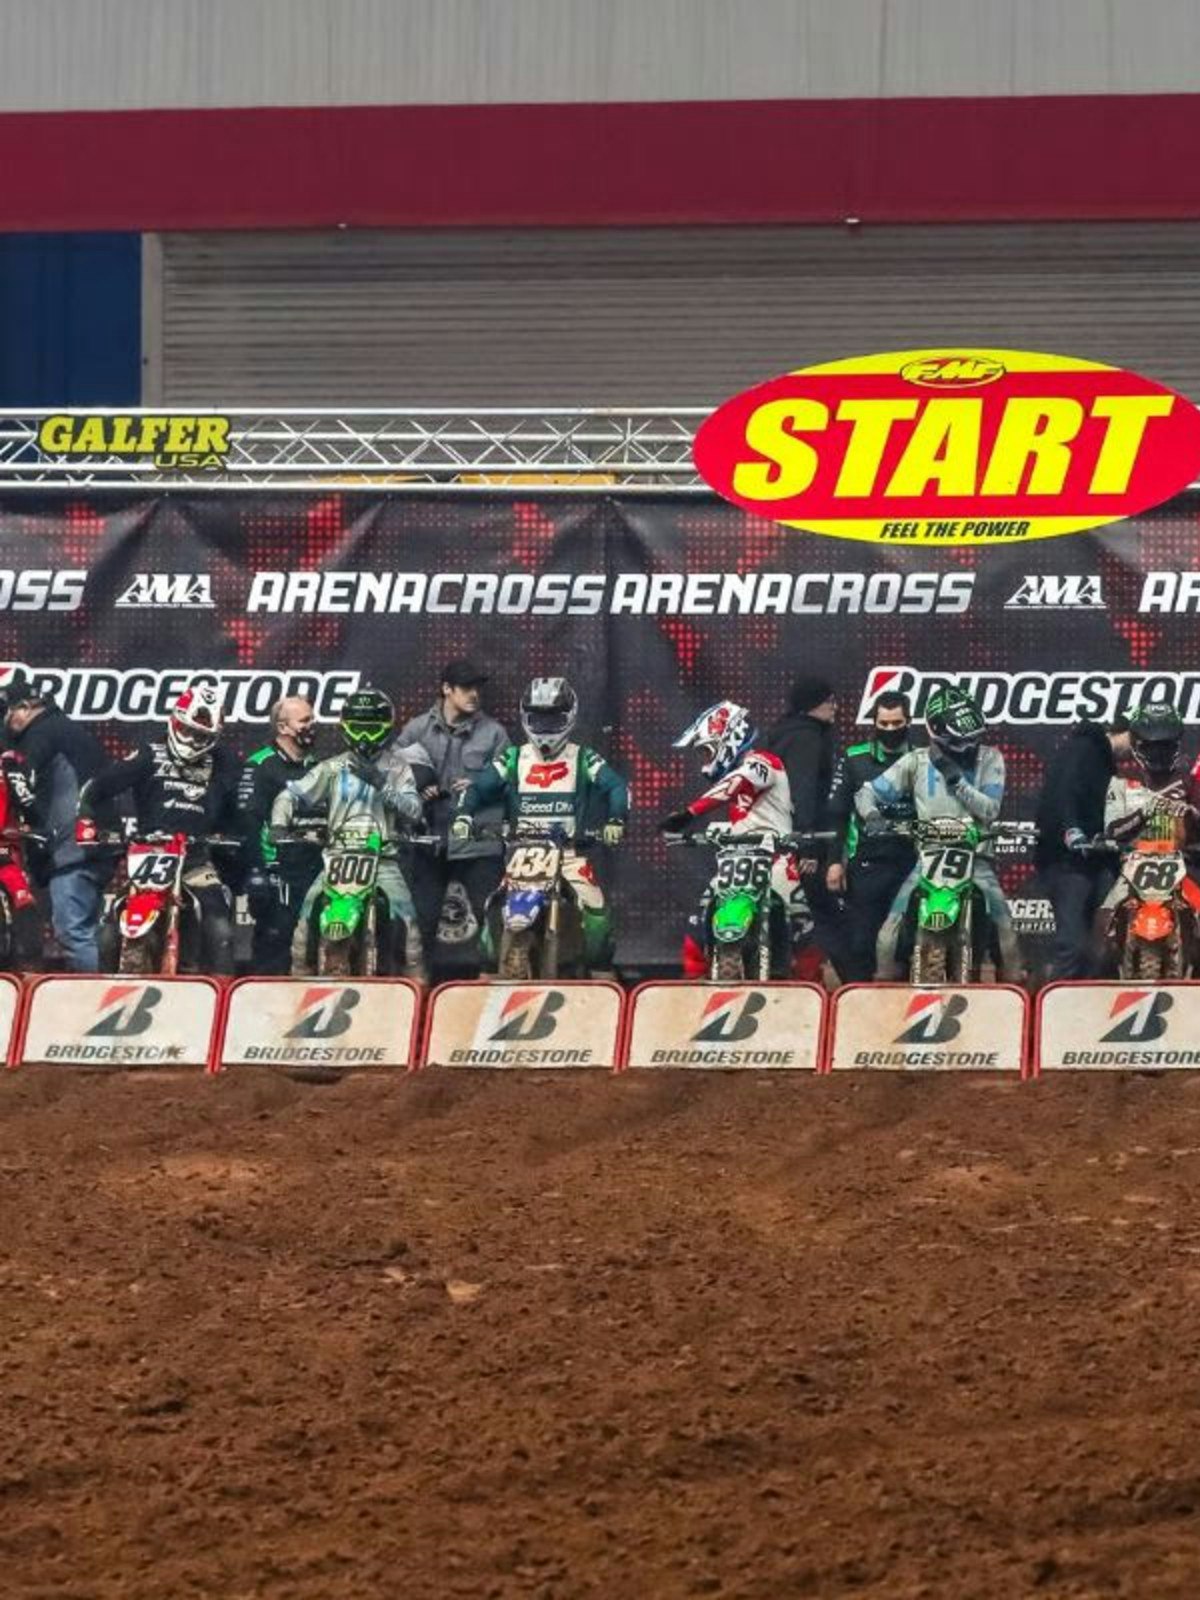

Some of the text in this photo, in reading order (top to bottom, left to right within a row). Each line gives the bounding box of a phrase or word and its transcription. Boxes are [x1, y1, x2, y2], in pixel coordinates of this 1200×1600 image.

[903, 358, 1003, 381] FMF
[40, 416, 229, 453] GALFER
[732, 396, 1174, 499] START
[155, 453, 224, 468] USA
[880, 521, 1030, 538] FEEL THE POWER
[0, 570, 88, 610] OSS
[115, 573, 213, 603] AMA
[247, 571, 606, 614] ARENACROSS
[610, 571, 976, 614] ARENACROSS
[1005, 574, 1106, 604] AMA
[132, 856, 178, 884] 43
[327, 856, 373, 885] 800
[506, 848, 559, 877] 434
[717, 857, 771, 890] 996
[924, 850, 973, 880] 79
[1132, 861, 1179, 890] 68
[243, 1045, 388, 1061] BRIDGESTONE
[449, 1048, 593, 1063] BRIDGESTONE
[651, 1049, 794, 1064] BRIDGESTONE
[854, 1051, 999, 1066] BRIDGESTONE
